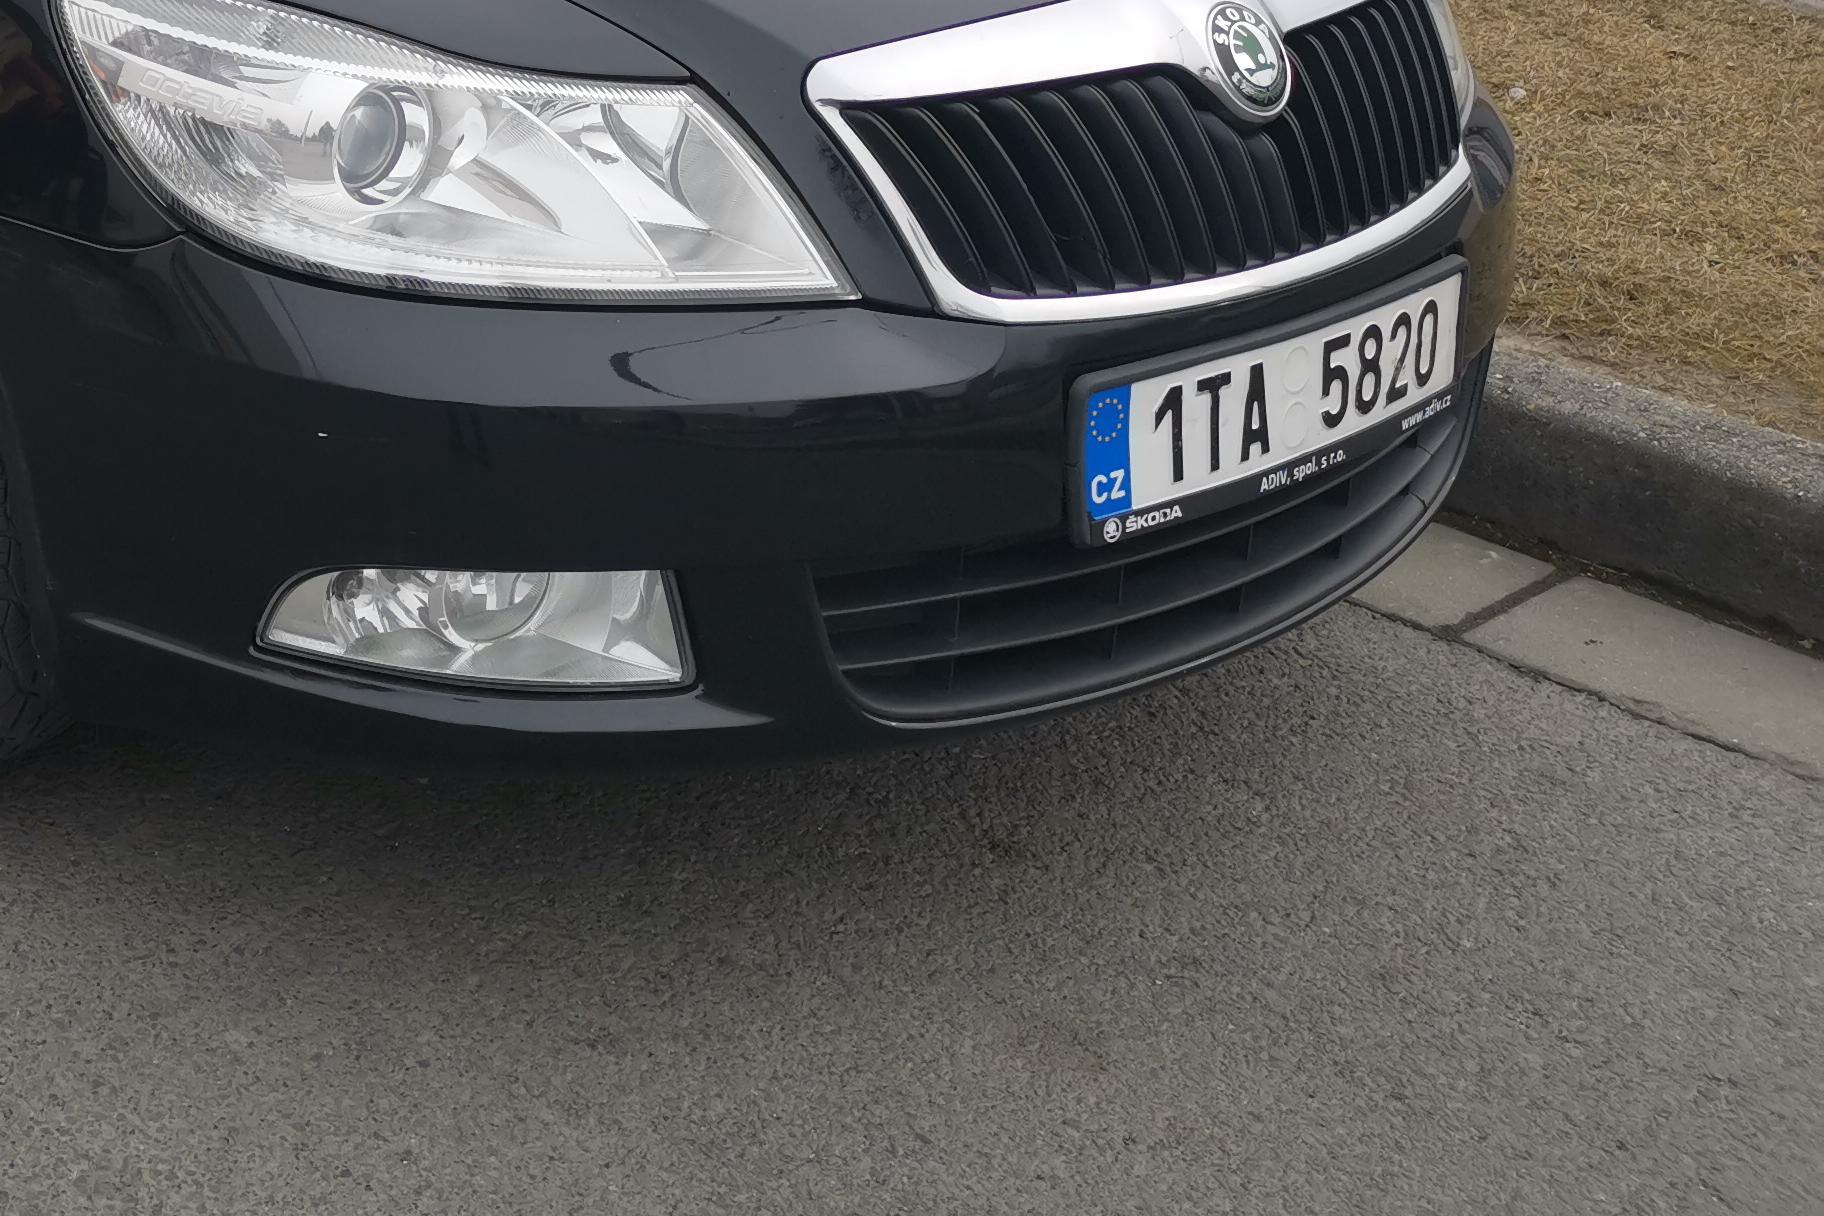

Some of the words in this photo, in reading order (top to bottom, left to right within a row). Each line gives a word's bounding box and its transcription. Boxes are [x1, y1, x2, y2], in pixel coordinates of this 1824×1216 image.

[1153, 362, 1271, 484] 1TA
[1320, 298, 1439, 429] 5820
[1401, 394, 1452, 431] www.adiv.cz
[1091, 468, 1127, 504] CZ
[1259, 468, 1291, 493] ADIV,
[1293, 456, 1319, 482] spol.
[1321, 456, 1327, 469] s
[1329, 449, 1346, 465] r.o.
[1125, 505, 1183, 533] ŠKODA
